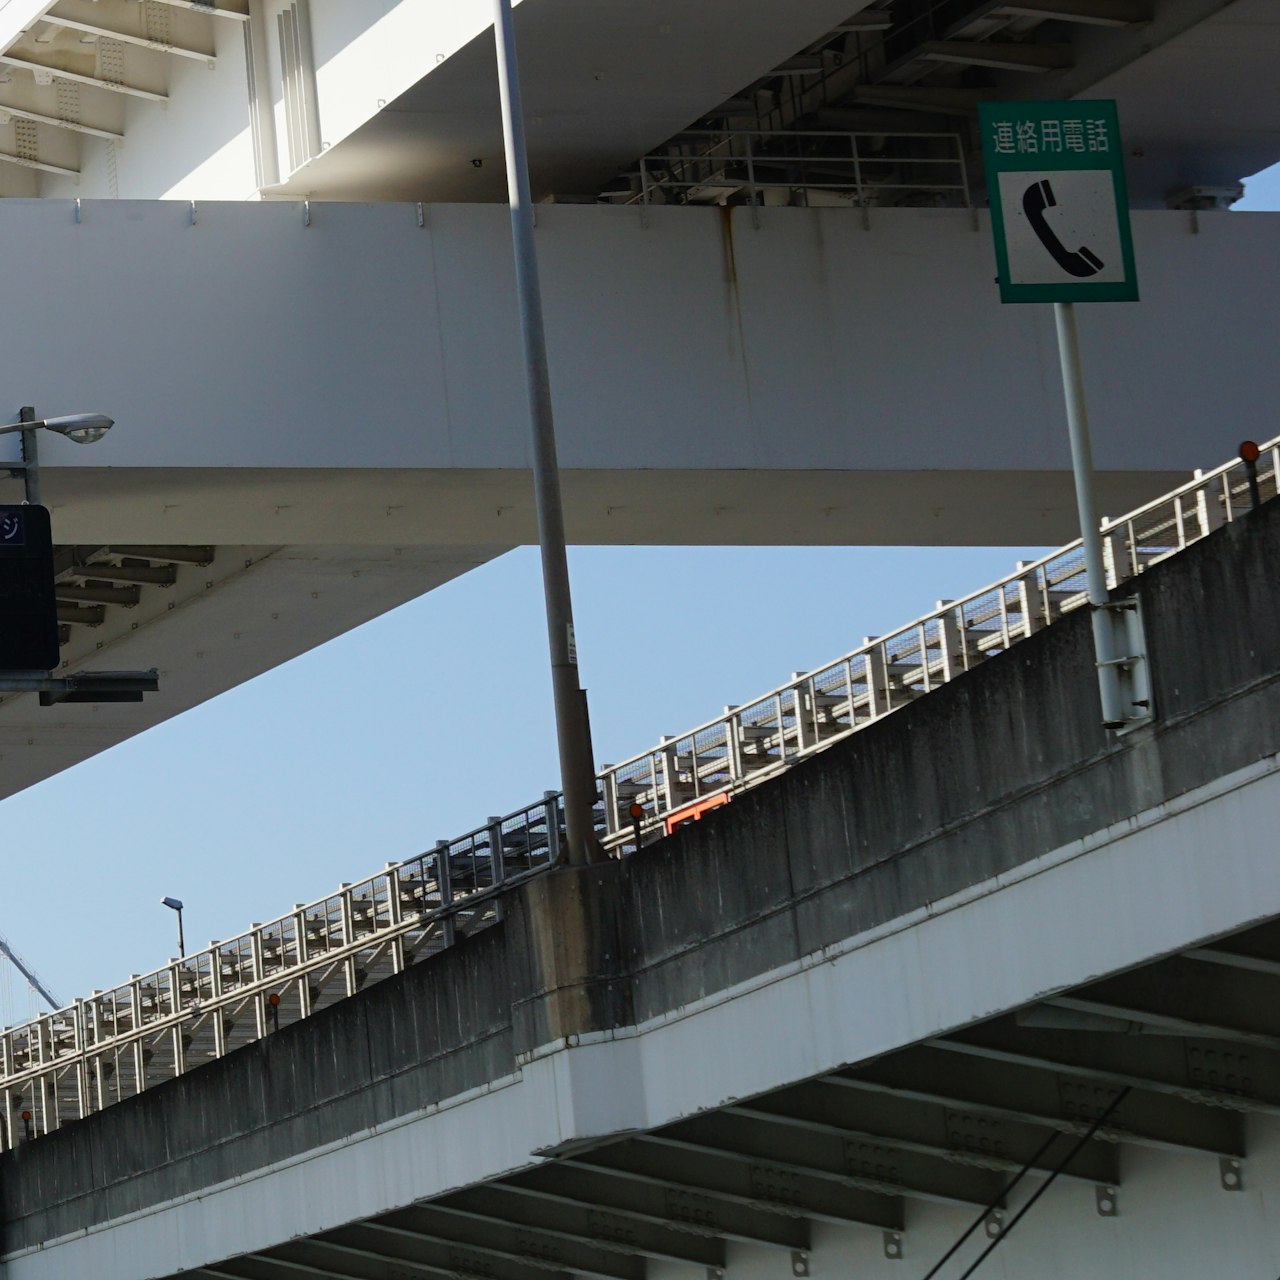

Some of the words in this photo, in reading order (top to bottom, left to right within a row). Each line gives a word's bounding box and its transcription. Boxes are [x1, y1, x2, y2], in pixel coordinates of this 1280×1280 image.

[992, 119, 1109, 153] 連絡用電話
